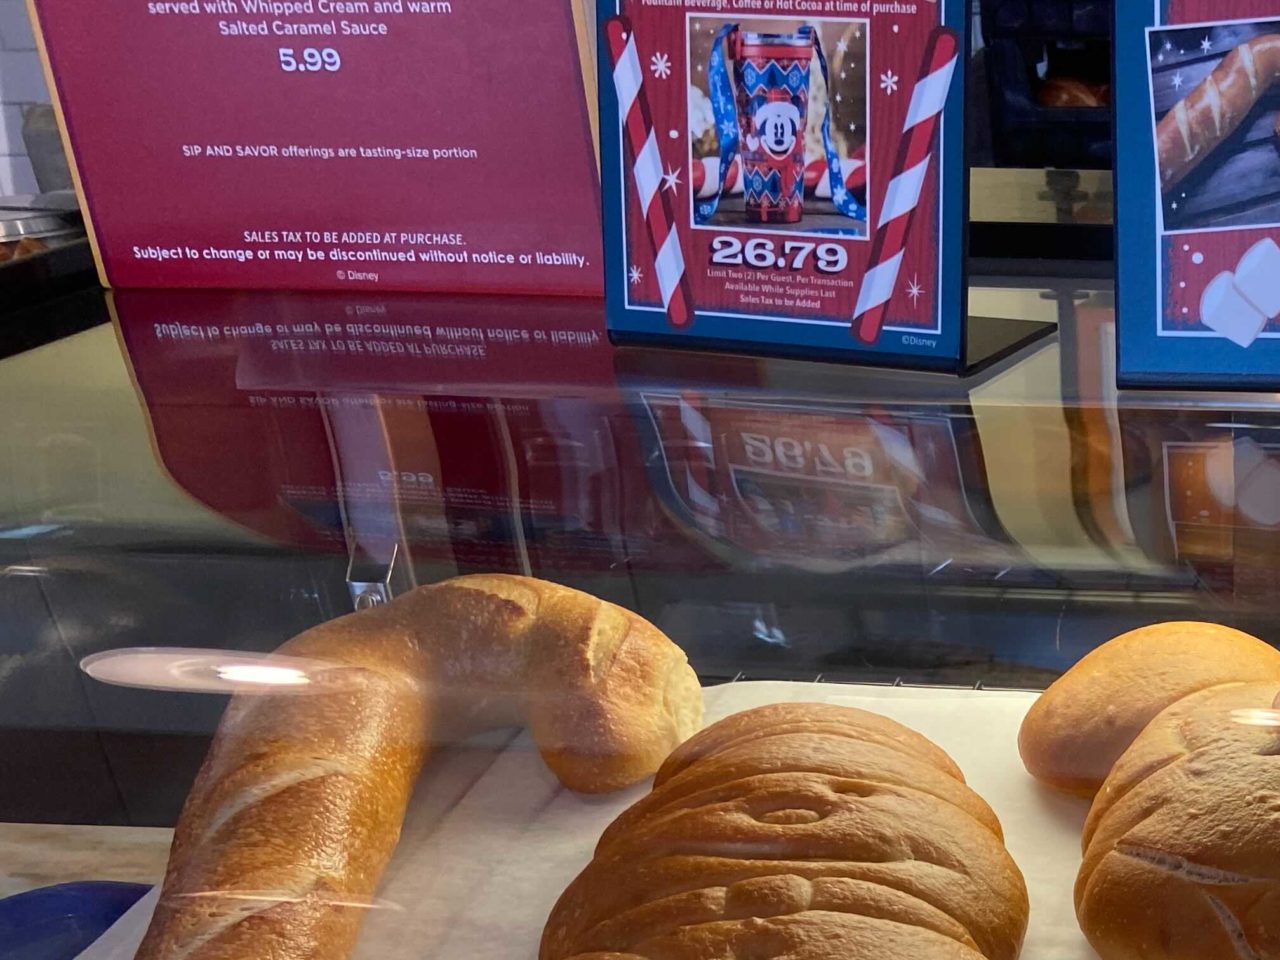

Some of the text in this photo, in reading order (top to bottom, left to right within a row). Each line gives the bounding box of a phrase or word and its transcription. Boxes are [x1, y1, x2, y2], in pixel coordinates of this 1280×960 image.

[148, 0, 452, 16] served with Whipped Cream and warm
[732, 0, 762, 9] Coffee
[764, 1, 774, 9] or
[776, 0, 793, 10] Hot
[795, 0, 823, 11] Cocoa
[824, 1, 835, 11] at
[836, 0, 859, 12] time
[861, 0, 871, 13] of
[872, 1, 917, 16] purchase
[219, 20, 388, 35] Salted Caramel Sauce
[279, 48, 341, 71] 5.99
[182, 145, 477, 160] SIP AND SAVOR offerings are tasting-size portion
[244, 231, 467, 246] SALES TAX TO BE ADDED AT PURCHASE.
[133, 246, 590, 268] Subject to change or may be discontinued without notice or liability.
[711, 236, 848, 272] 26.79
[348, 270, 379, 282] Disney
[707, 268, 727, 278] Limit
[728, 270, 743, 279] Two
[744, 271, 755, 281] (2)
[757, 272, 769, 281] Per
[796, 275, 809, 284] Per
[810, 276, 854, 287] Transaction
[724, 282, 836, 299] Available While Supplies Last
[739, 294, 821, 309] Sales Tax to be Added
